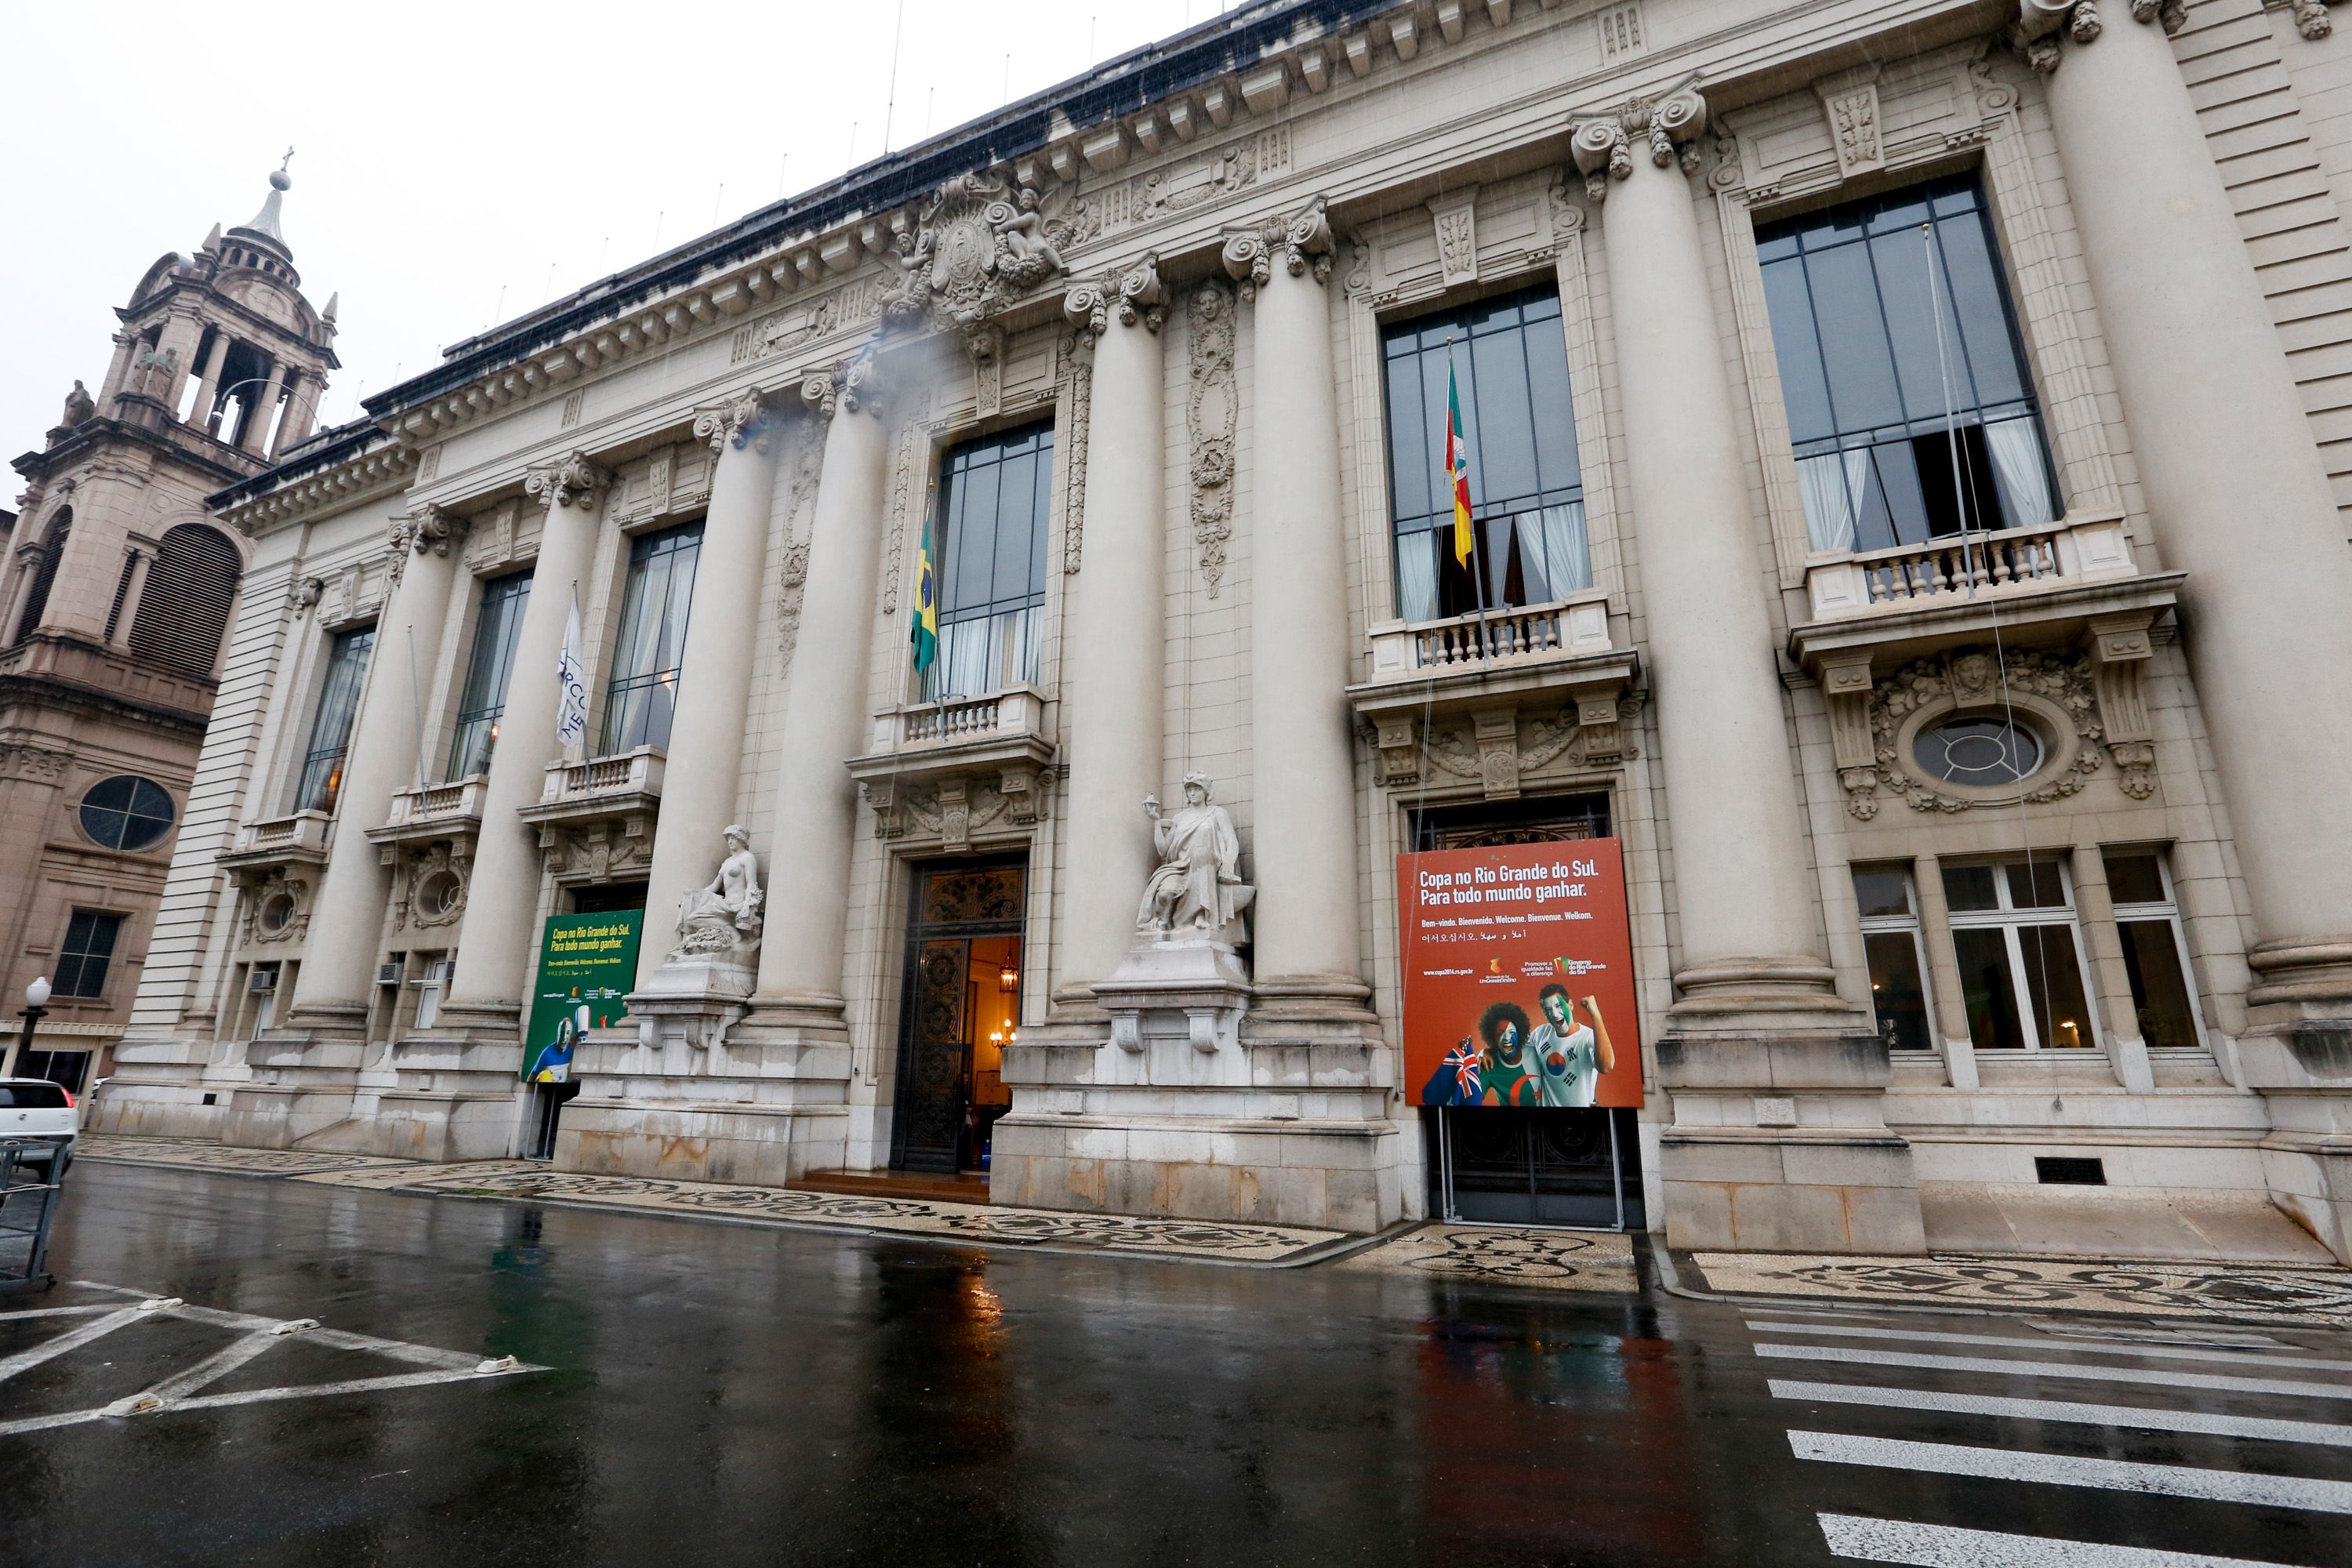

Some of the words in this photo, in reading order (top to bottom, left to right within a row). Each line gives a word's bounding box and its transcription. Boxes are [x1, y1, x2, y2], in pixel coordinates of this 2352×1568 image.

[1420, 870, 1452, 891] Copa
[1455, 872, 1472, 885] no
[1475, 866, 1496, 884] Rio
[1499, 862, 1548, 882] Grande
[1552, 861, 1569, 878] do
[1572, 858, 1599, 877] Sul.
[1421, 889, 1450, 906] Para
[1453, 886, 1482, 904] todo
[1486, 883, 1532, 902] mundo
[1536, 880, 1588, 903] ganhar.
[1421, 918, 1457, 927] Bem-vindo.
[1458, 916, 1494, 926] Bienvenido.
[1495, 914, 1526, 924] Welcome.
[1527, 913, 1563, 922] Bienvenue.
[1564, 911, 1593, 920] Welkom.
[553, 928, 568, 942] Copa
[568, 930, 576, 938] no
[576, 927, 586, 938] Rio
[587, 925, 609, 937] Grande
[609, 924, 617, 935] do
[1421, 932, 1478, 943] 어서오십시오.
[551, 941, 564, 952] Para
[564, 939, 578, 951] todo
[579, 938, 599, 950] mundo
[600, 937, 622, 952] ganhar.
